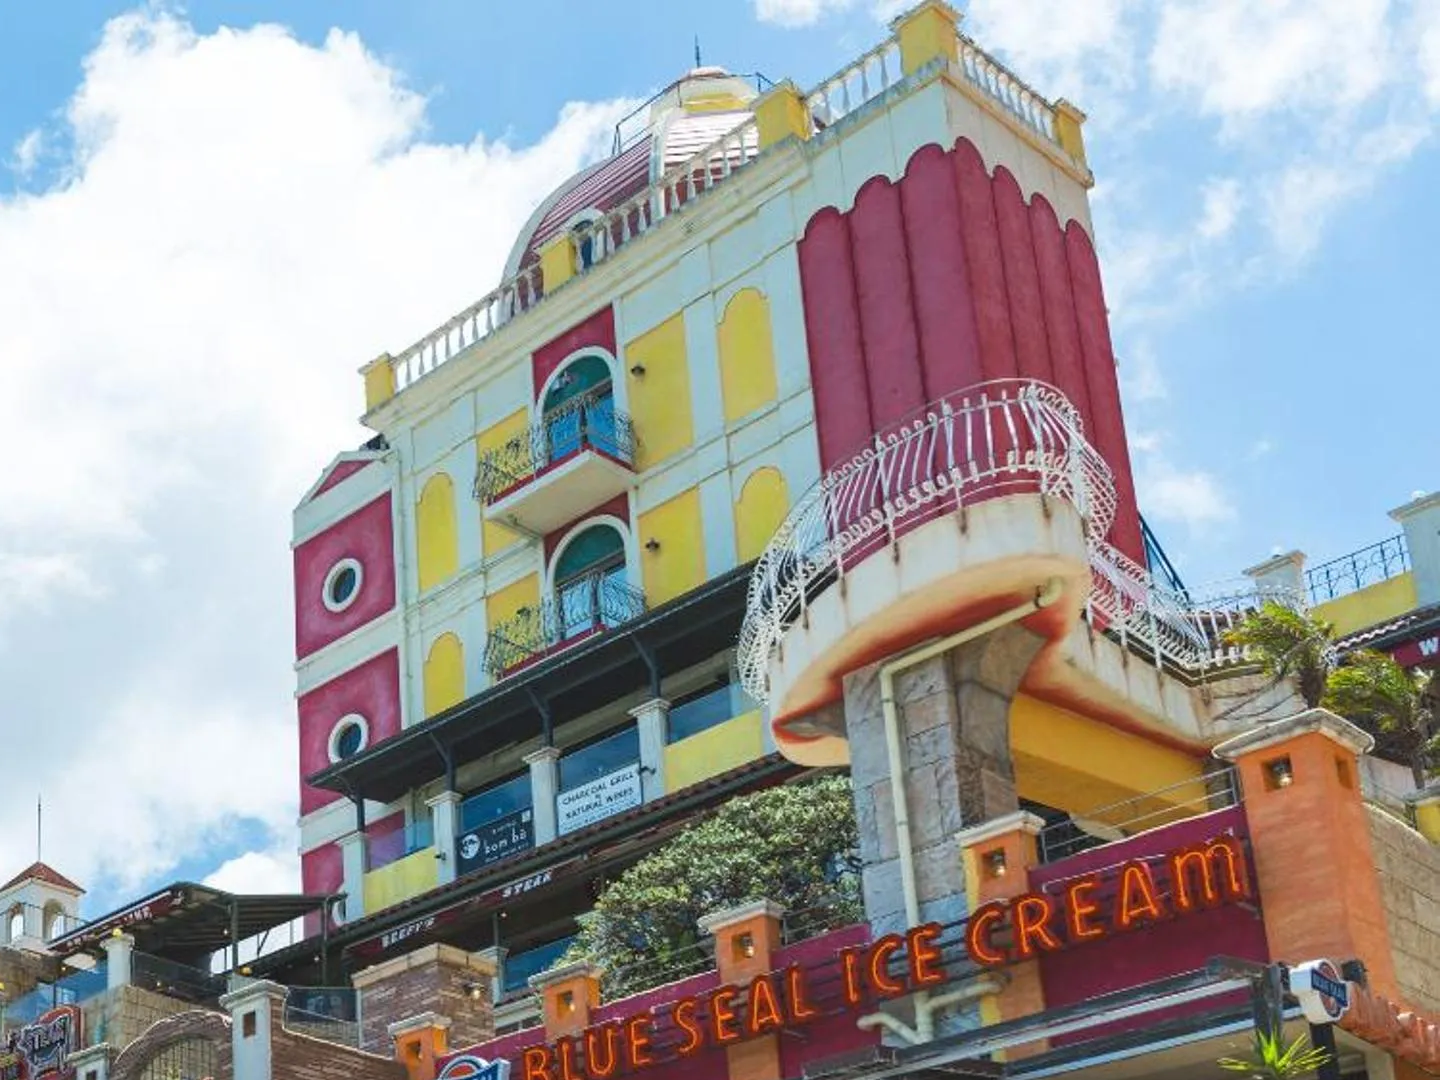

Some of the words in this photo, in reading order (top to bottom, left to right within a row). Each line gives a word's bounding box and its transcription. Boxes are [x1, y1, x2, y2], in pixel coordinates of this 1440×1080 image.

[562, 782, 608, 805] CHARCOAL
[609, 773, 635, 789] GRILL
[565, 799, 603, 820] NATURAL
[502, 870, 553, 899] STEAK
[673, 963, 815, 1057] SEAL
[840, 923, 945, 1004] ICE
[965, 836, 1250, 966] CREAM
